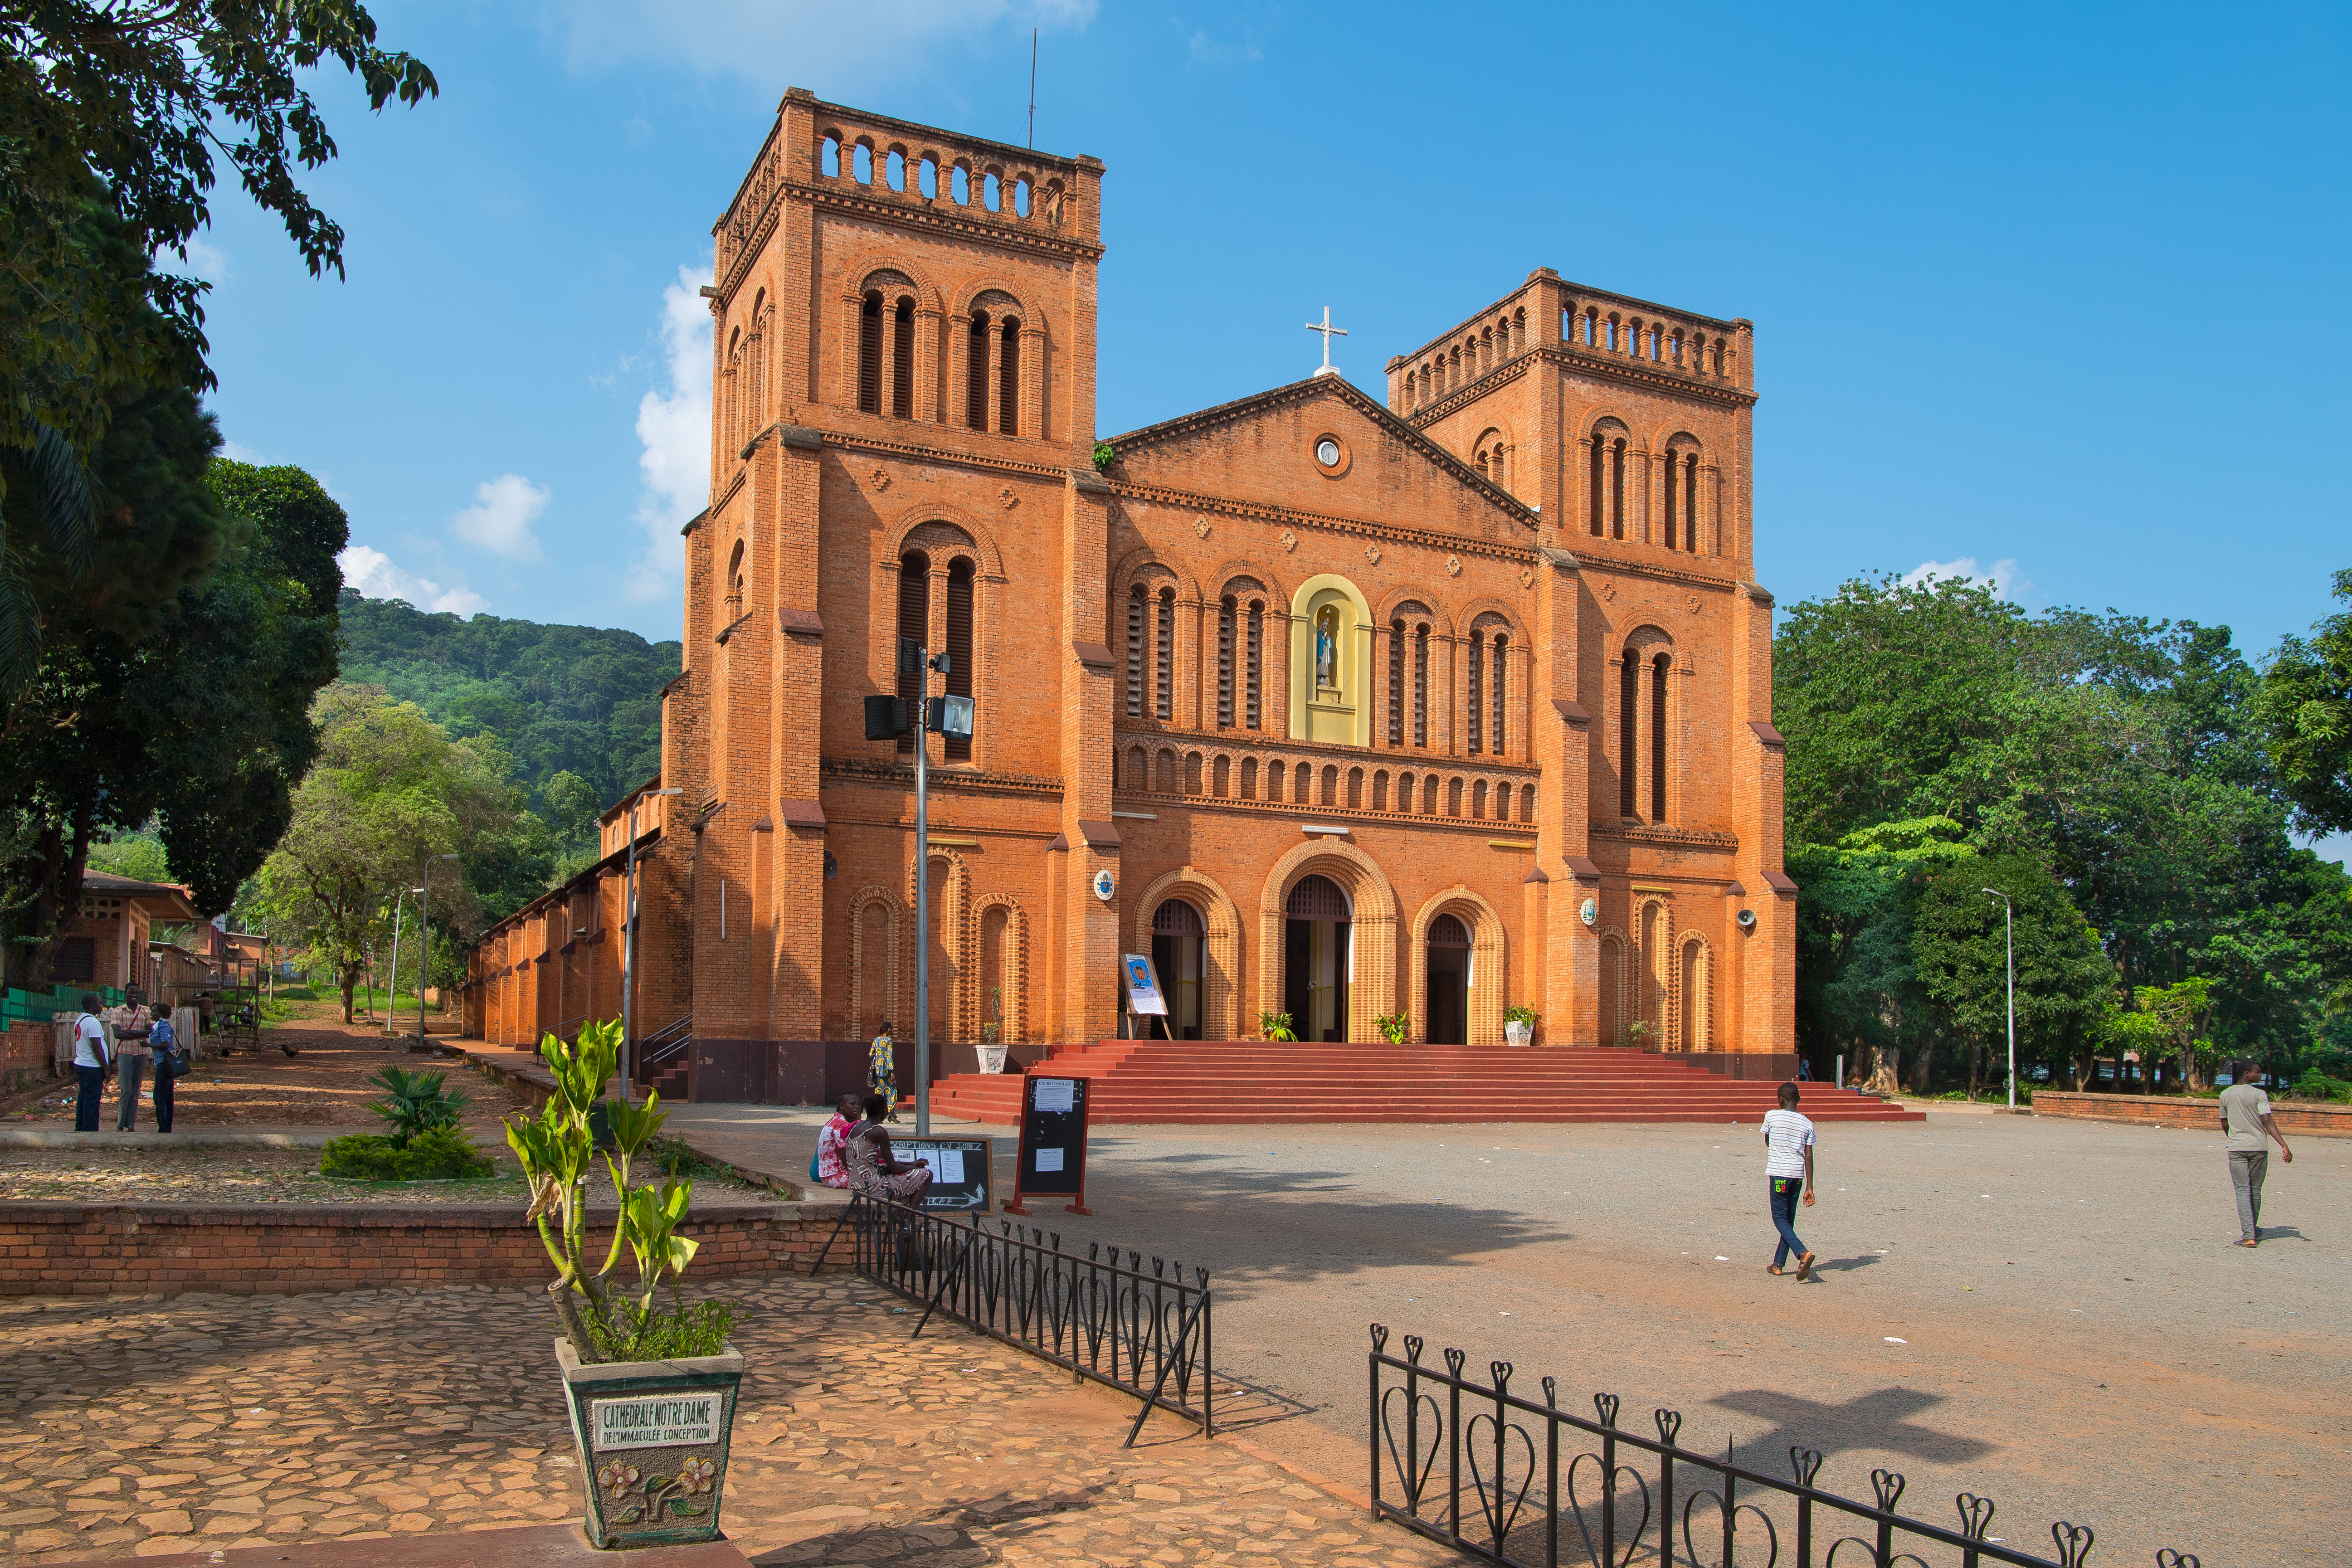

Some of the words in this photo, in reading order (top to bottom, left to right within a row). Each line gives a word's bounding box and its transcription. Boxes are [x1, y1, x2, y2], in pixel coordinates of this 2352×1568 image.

[604, 1403, 653, 1428] CATHEDRALE
[654, 1401, 683, 1427] NOTRE
[683, 1400, 711, 1425] DAME
[604, 1432, 612, 1444] DE
[664, 1427, 710, 1440] CONCEPTION
